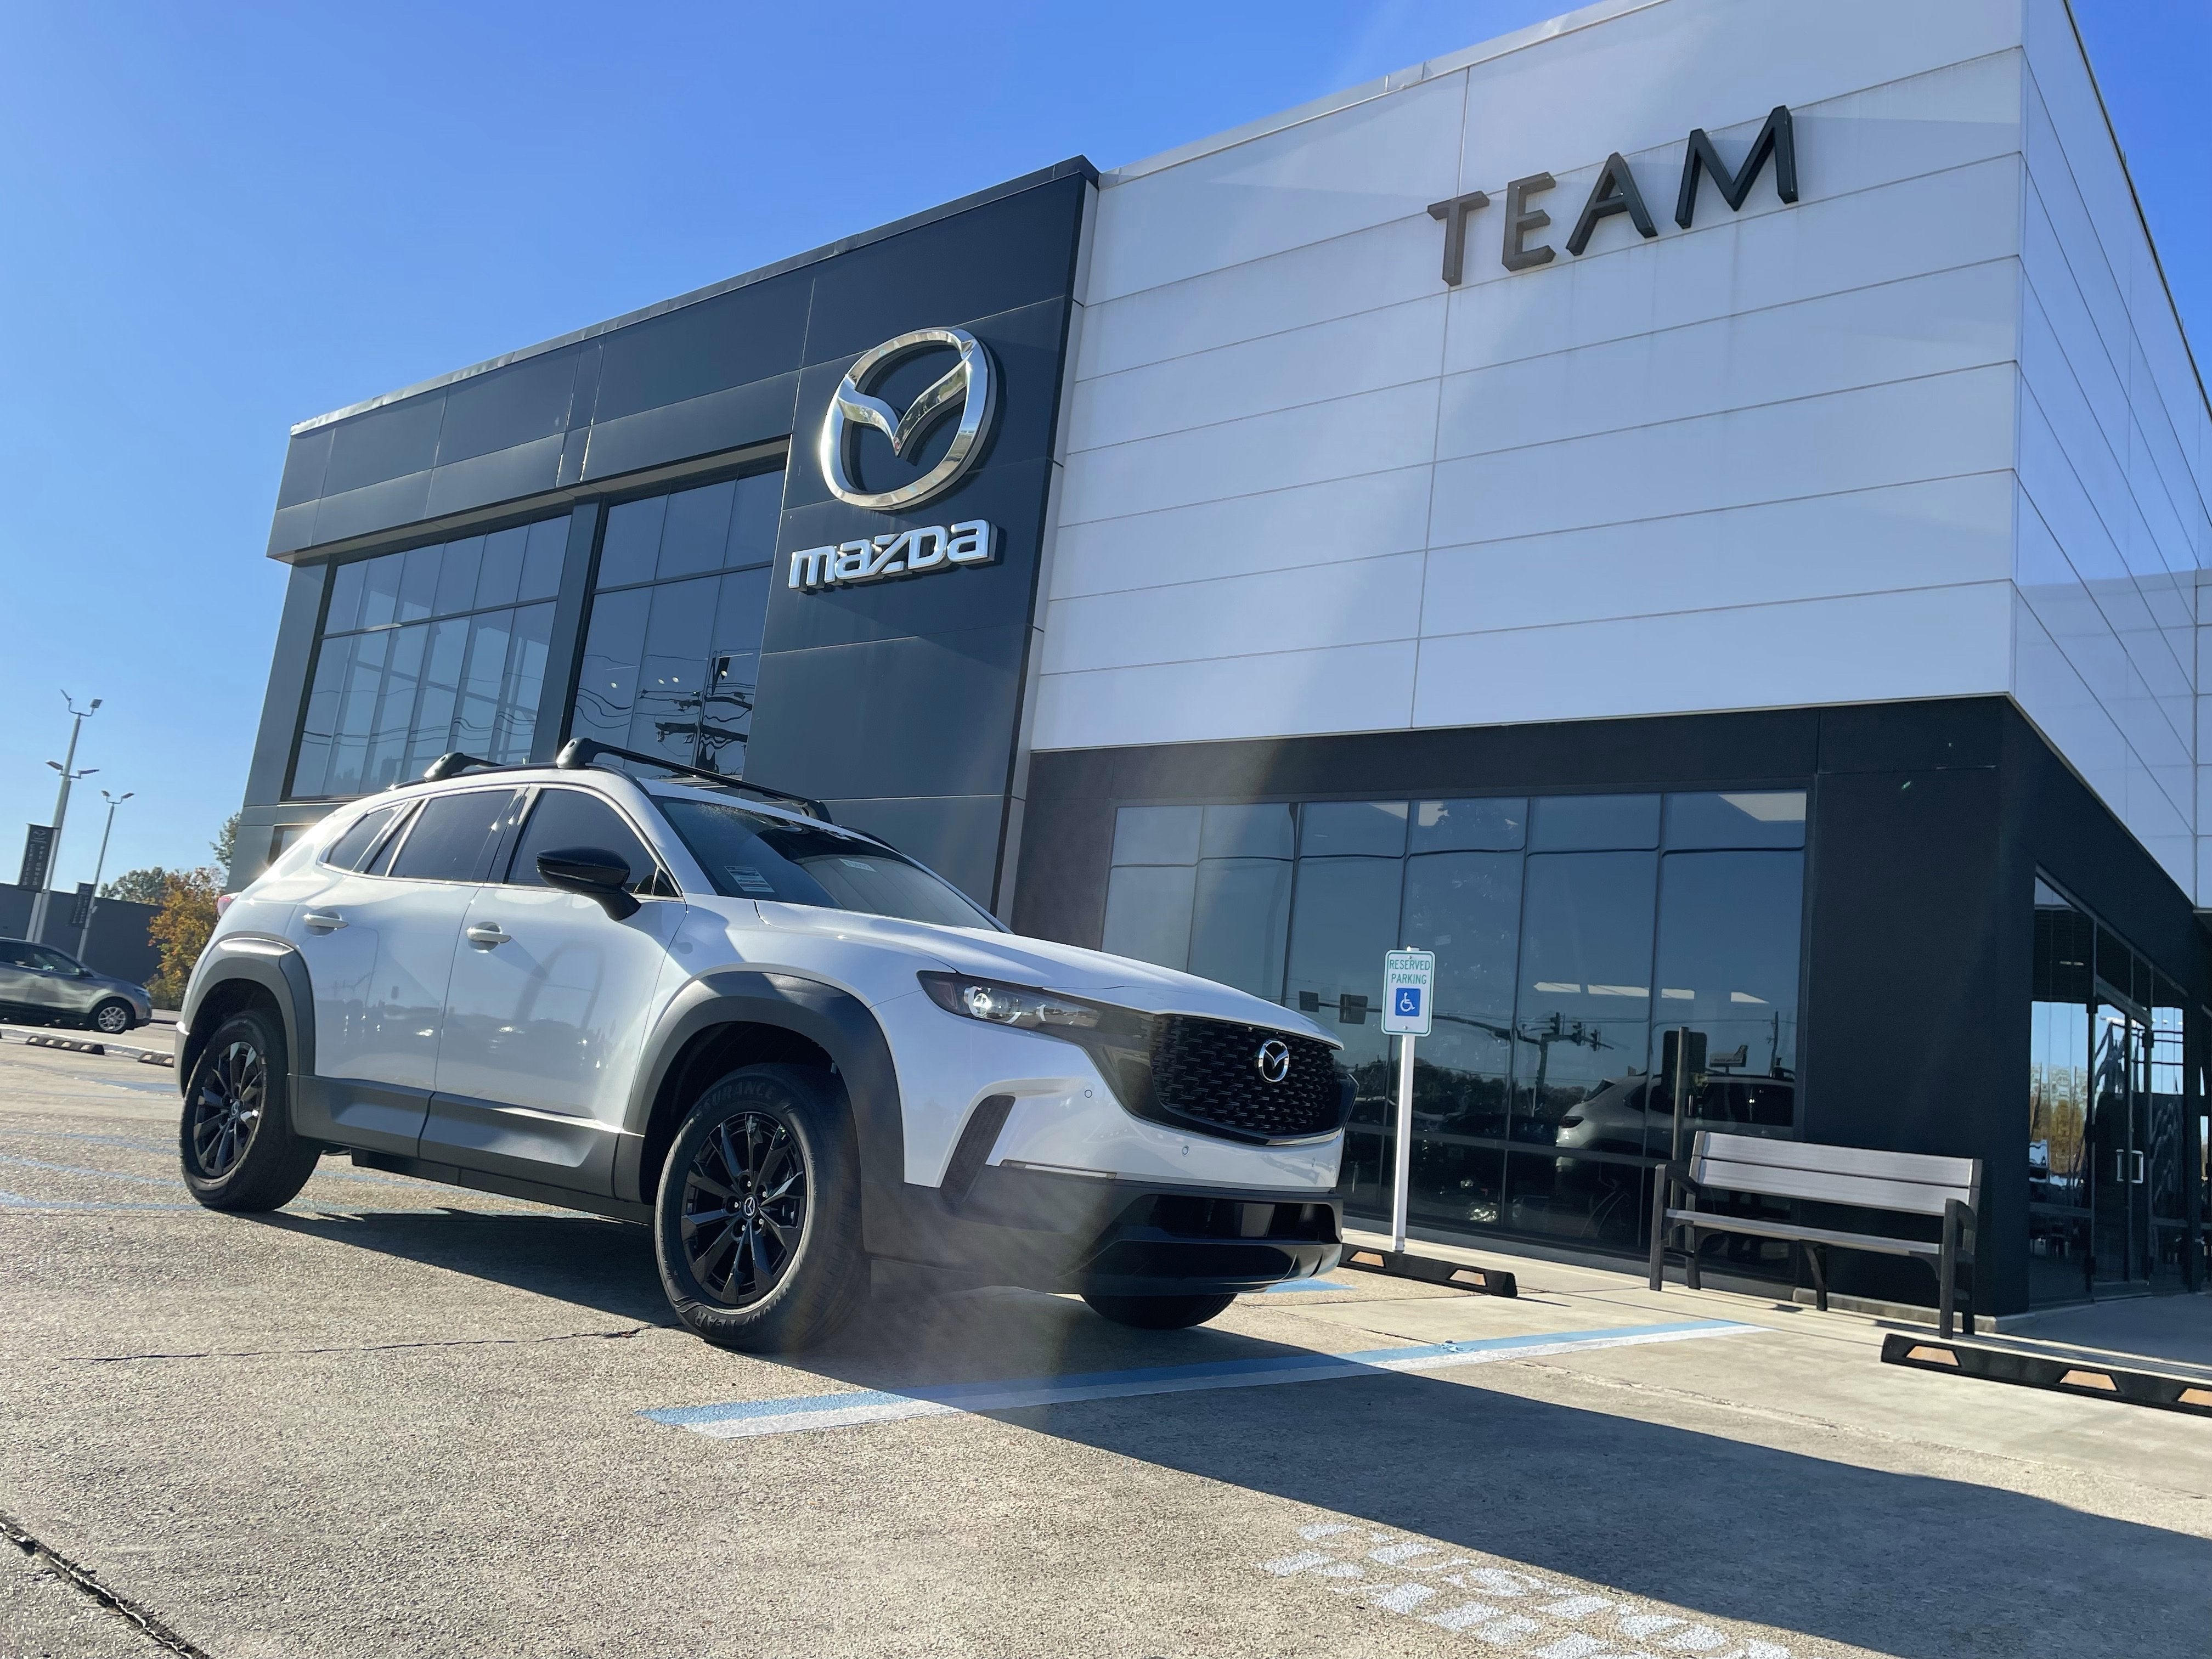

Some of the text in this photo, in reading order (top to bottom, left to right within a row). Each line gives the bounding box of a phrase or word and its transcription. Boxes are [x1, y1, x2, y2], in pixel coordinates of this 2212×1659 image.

[1427, 105, 1799, 286] TEAM
[1390, 960, 1430, 970] RESERVED
[1391, 974, 1426, 984] PARKING
